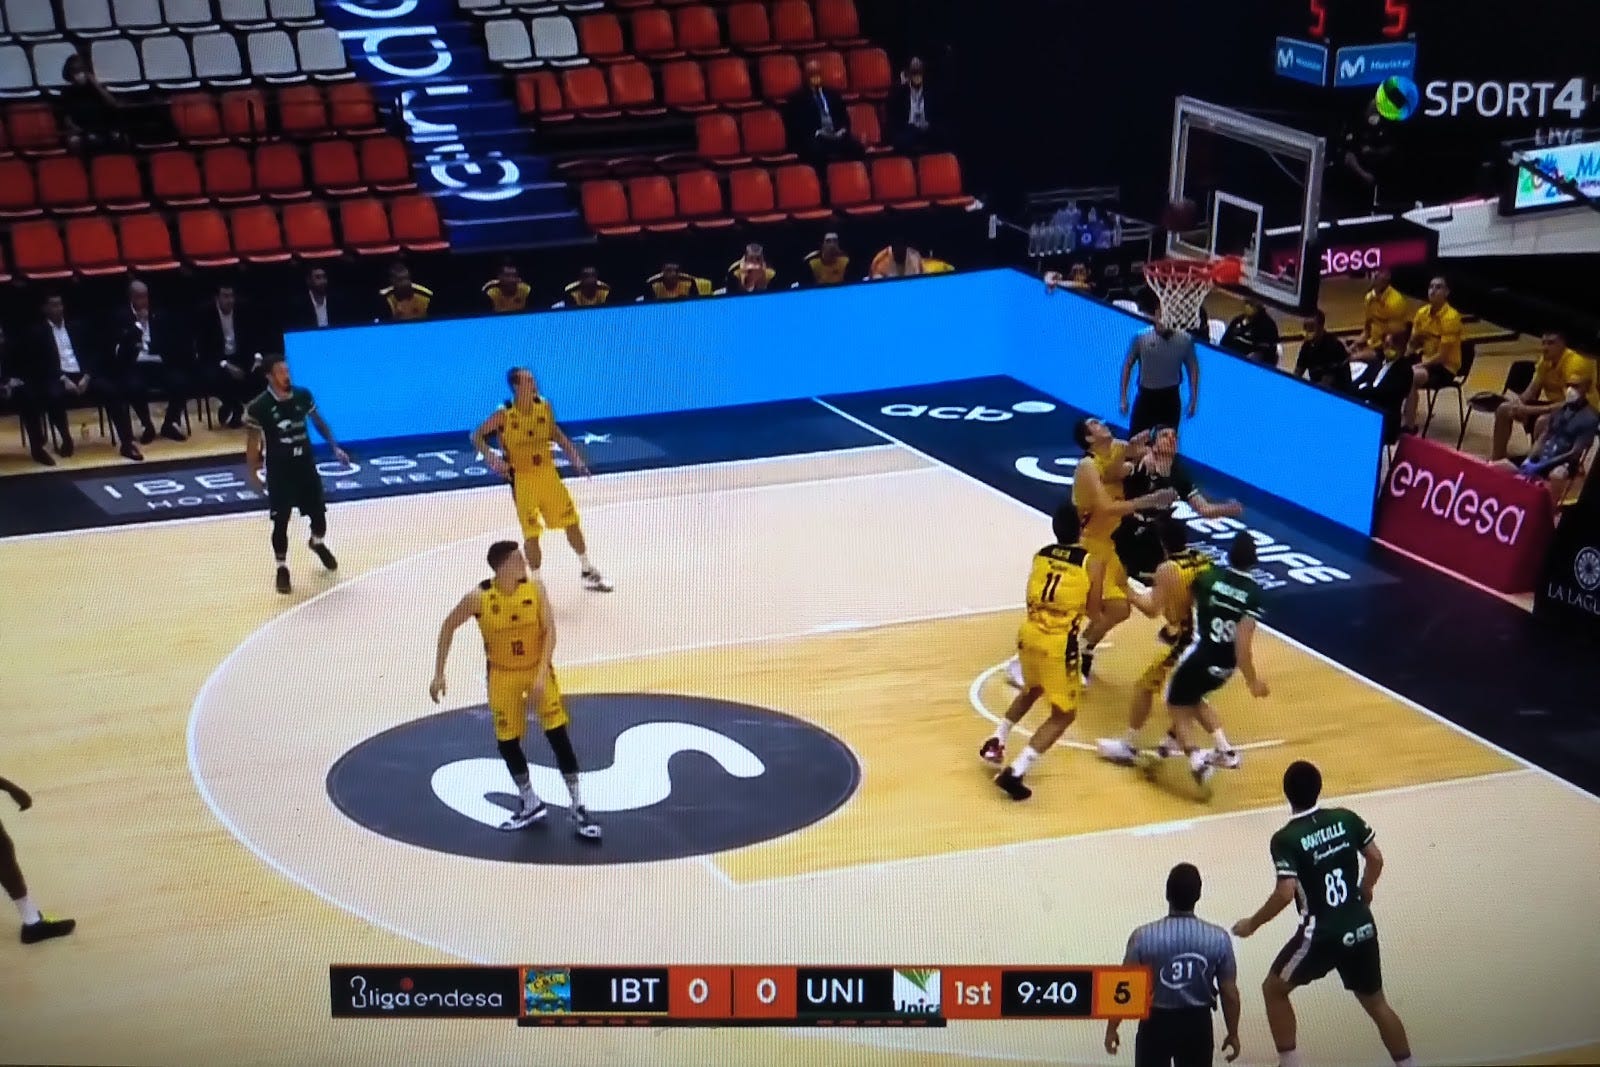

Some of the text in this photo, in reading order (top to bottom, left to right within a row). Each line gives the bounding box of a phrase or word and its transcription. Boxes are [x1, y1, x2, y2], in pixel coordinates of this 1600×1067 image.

[1423, 77, 1586, 119] SPORT4
[1319, 247, 1381, 275] desa
[880, 402, 1014, 422] acb
[1390, 461, 1526, 546] endesa
[1041, 572, 1061, 602] 11
[1547, 582, 1564, 601] LA
[1324, 868, 1347, 907] 83
[1171, 961, 1193, 981] 31
[611, 978, 660, 1003] IBT
[687, 978, 709, 1004] 0
[756, 978, 777, 1004] 0
[806, 978, 865, 1004] UNI
[954, 980, 992, 1006] 1st
[1016, 980, 1078, 1005] 9:40
[1113, 980, 1132, 1005] 5
